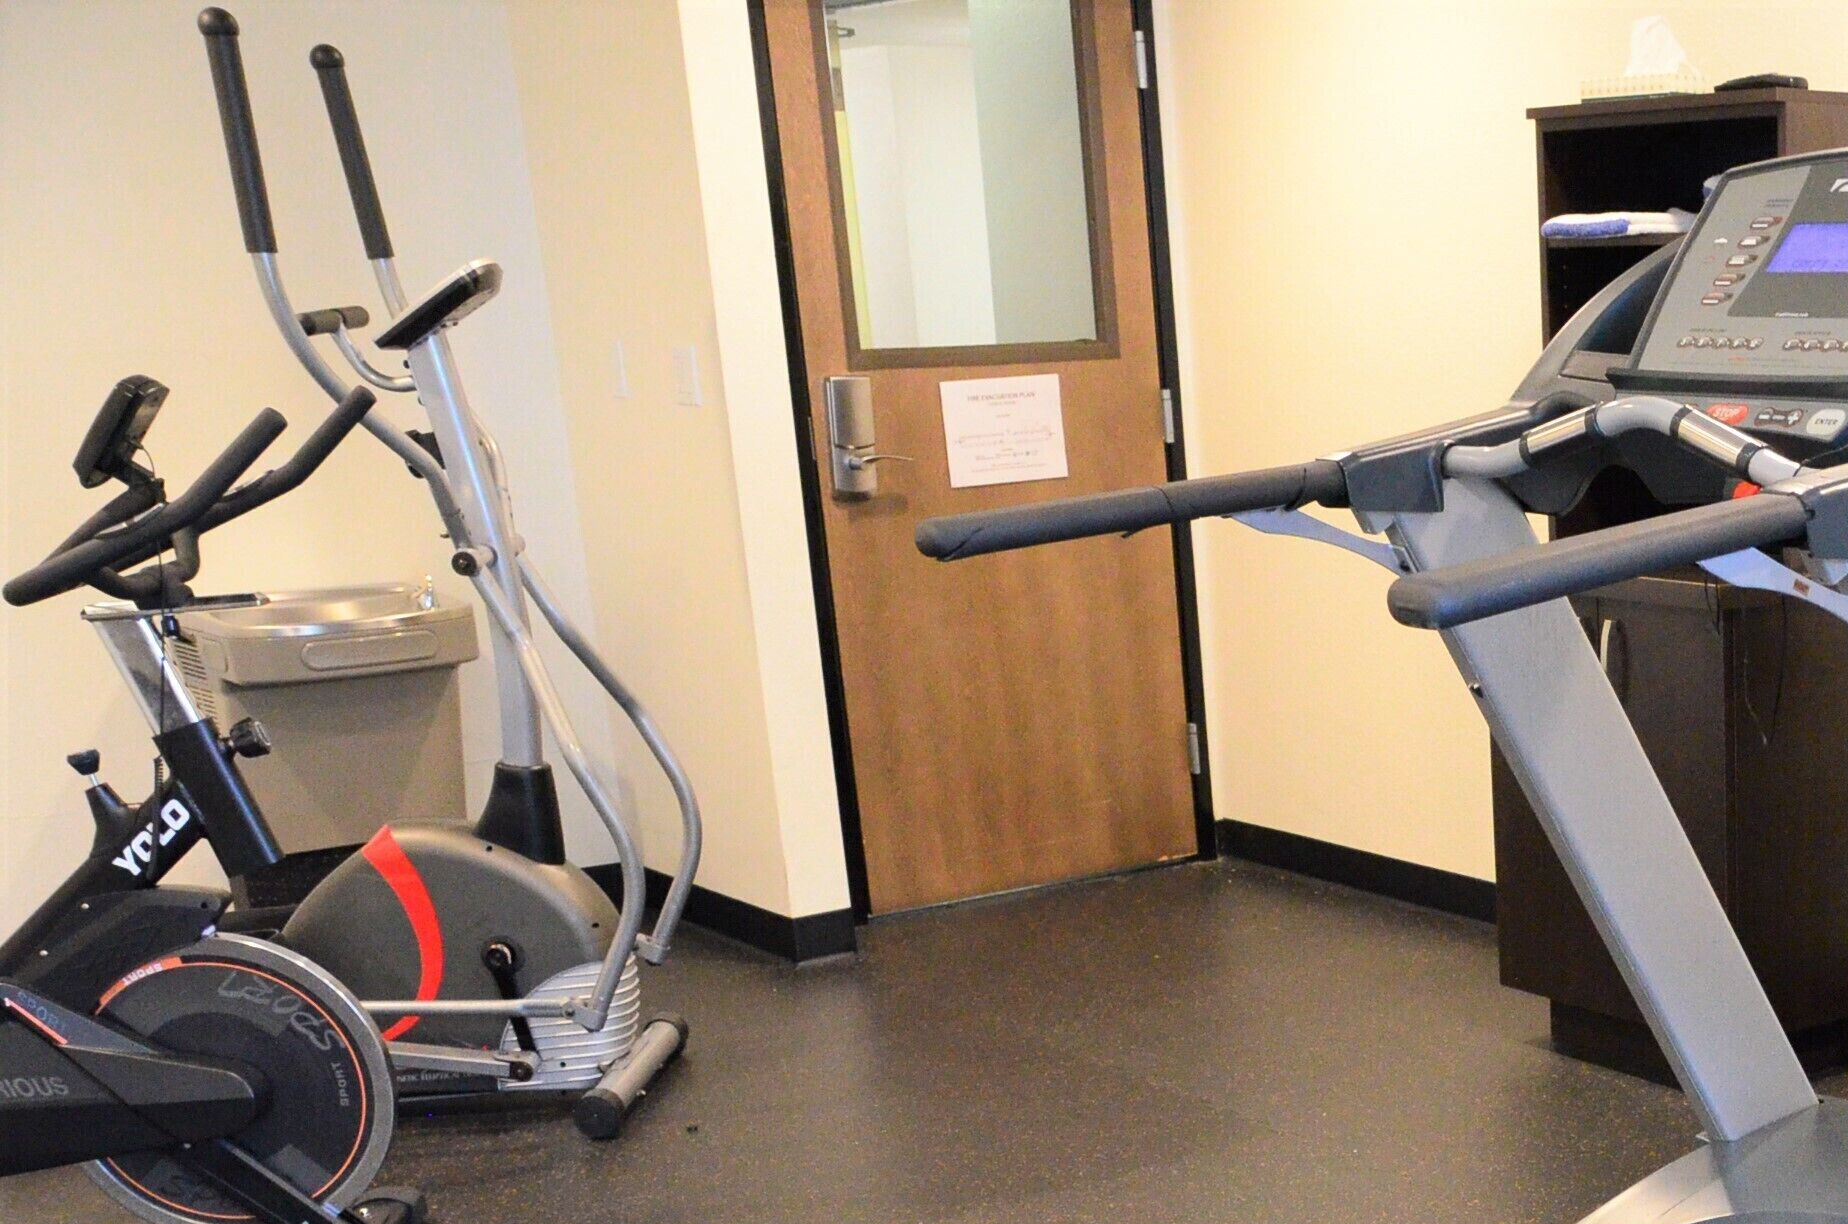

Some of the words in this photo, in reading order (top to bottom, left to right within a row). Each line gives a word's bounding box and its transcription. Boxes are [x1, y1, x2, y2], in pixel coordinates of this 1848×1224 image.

[1714, 407, 1741, 418] STOP
[1814, 418, 1839, 426] ENTER
[112, 798, 190, 877] YOLO
[121, 961, 163, 987] SPORT
[330, 1061, 350, 1107] SPORT
